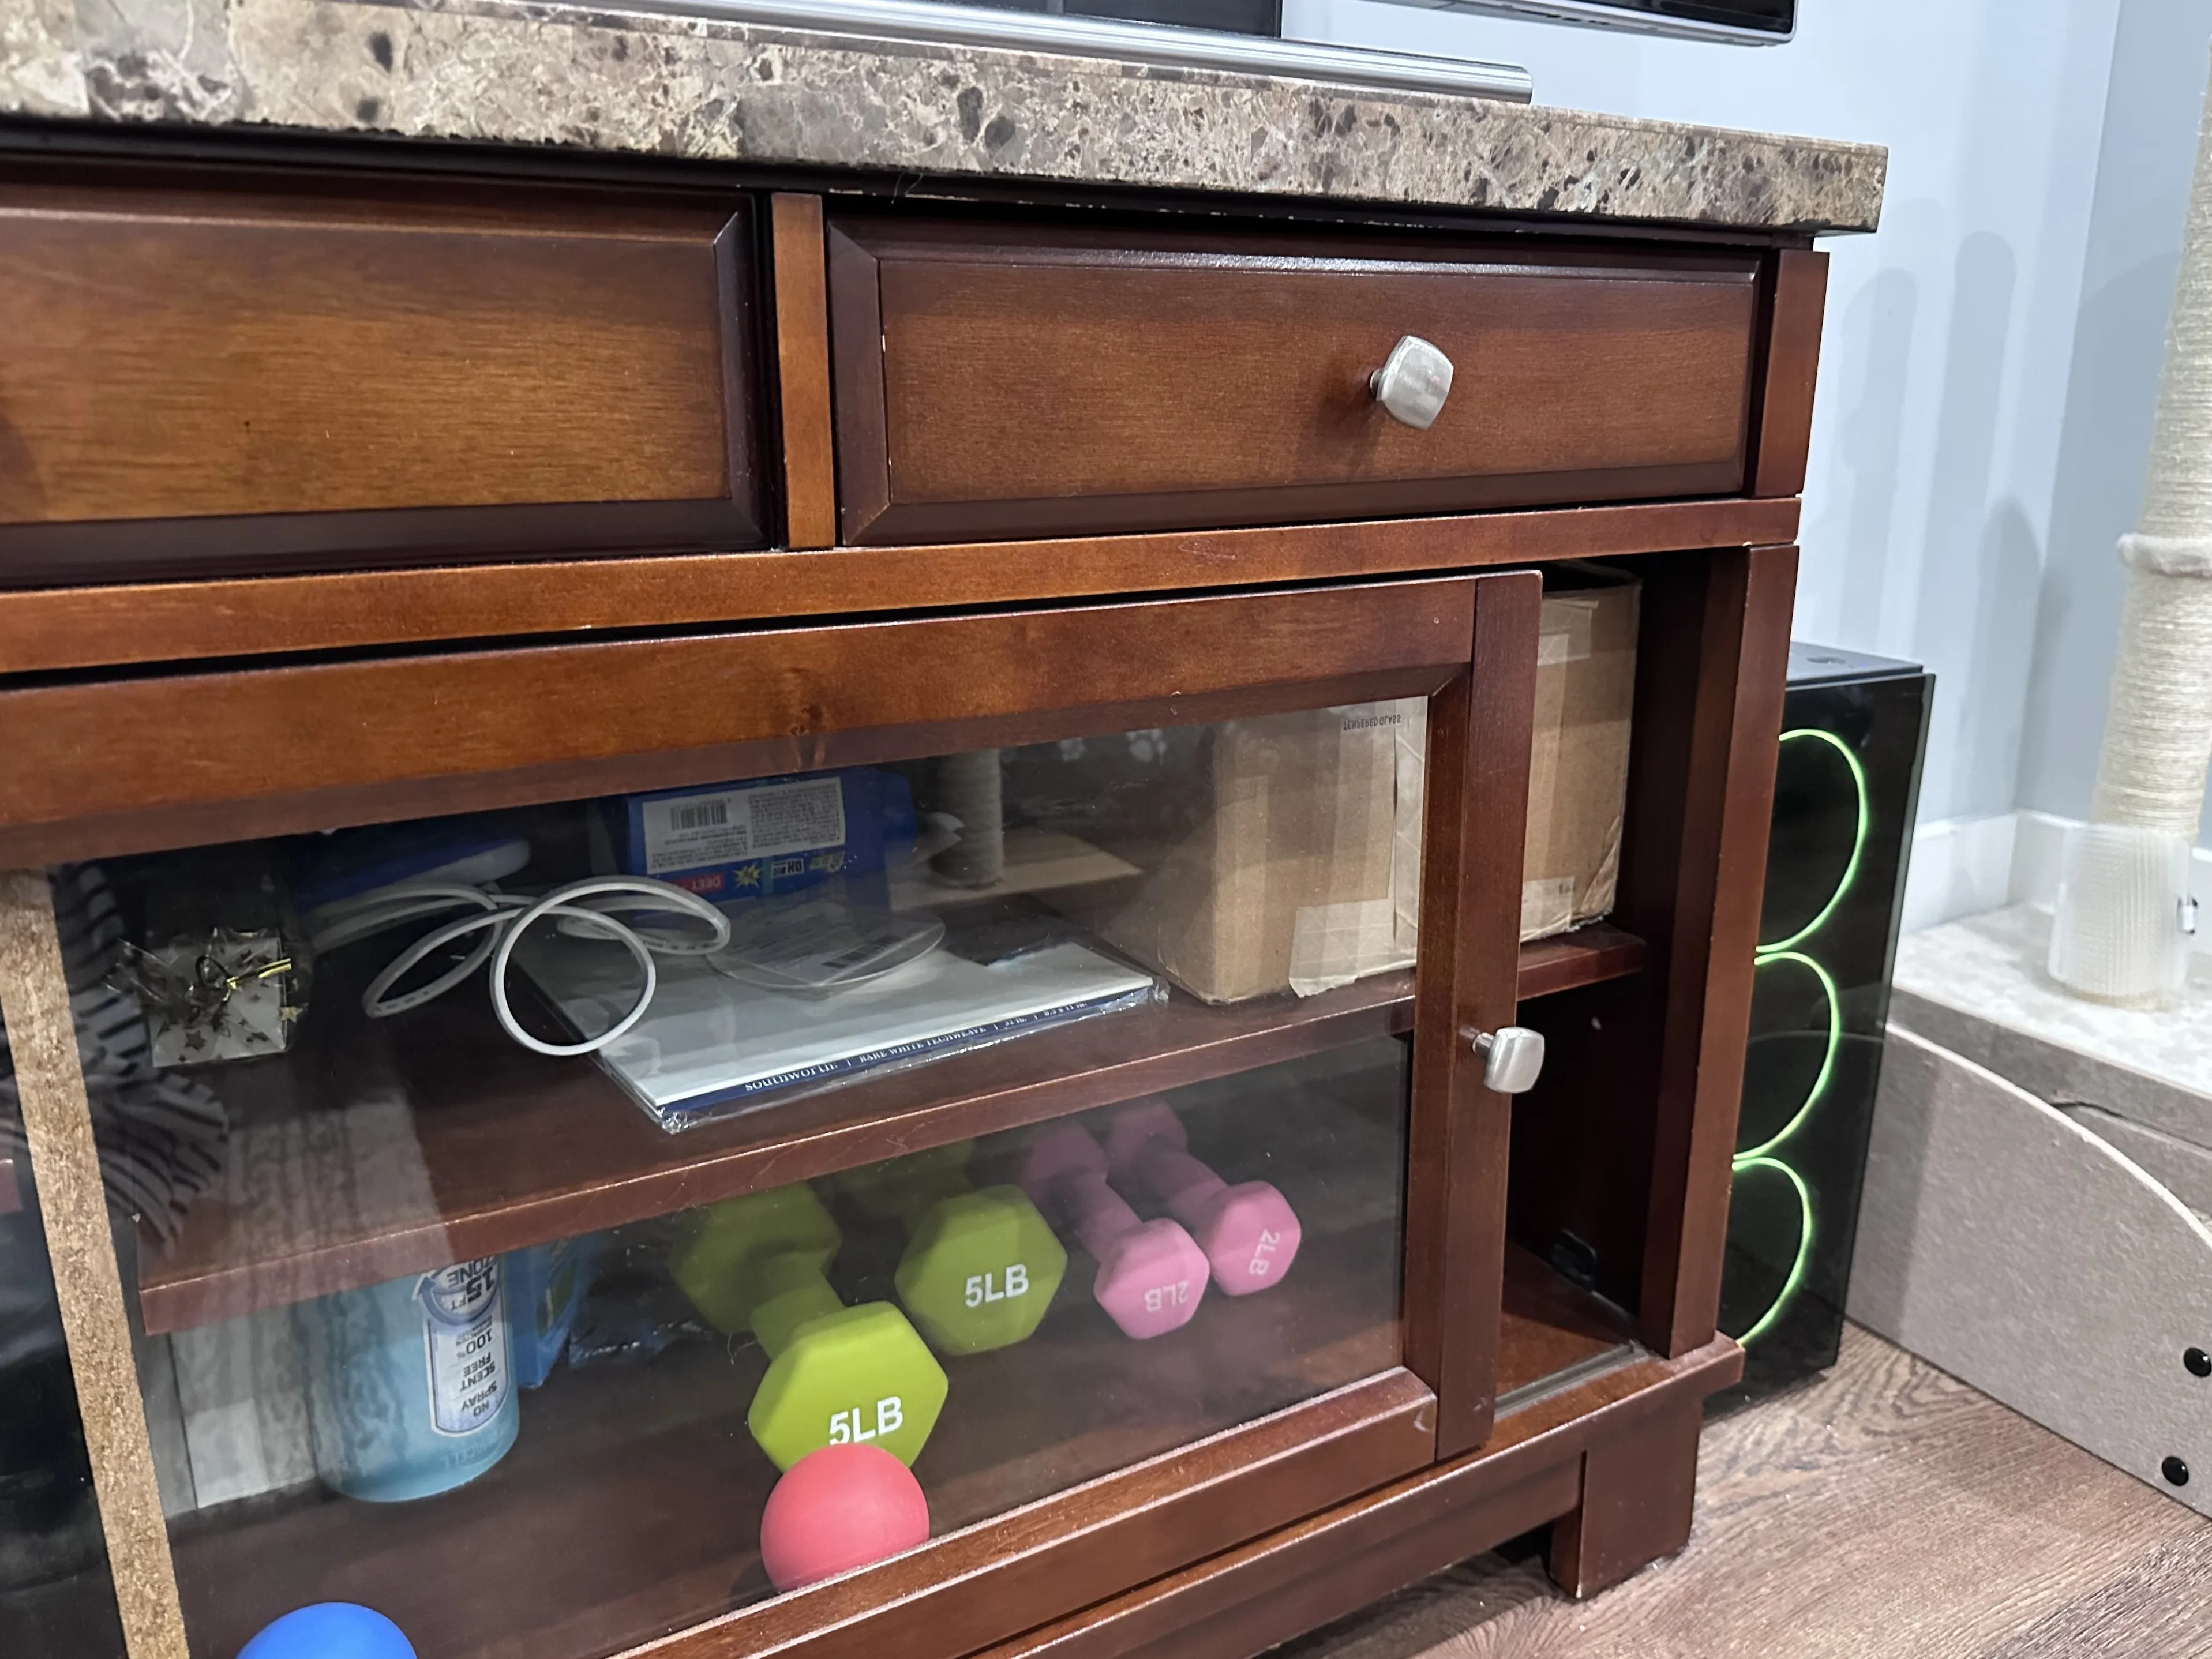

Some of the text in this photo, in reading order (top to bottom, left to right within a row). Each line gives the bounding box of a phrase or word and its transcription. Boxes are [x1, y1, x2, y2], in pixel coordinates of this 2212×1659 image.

[1248, 1228, 1281, 1276] 2LB
[965, 1263, 1029, 1308] 5LB
[1144, 1279, 1189, 1312] 2LB
[459, 1361, 496, 1392] SCENT
[463, 1352, 491, 1377] FREE
[462, 1380, 497, 1412] SPRAY
[474, 1399, 489, 1417] NO
[829, 1396, 903, 1446] 5LB
